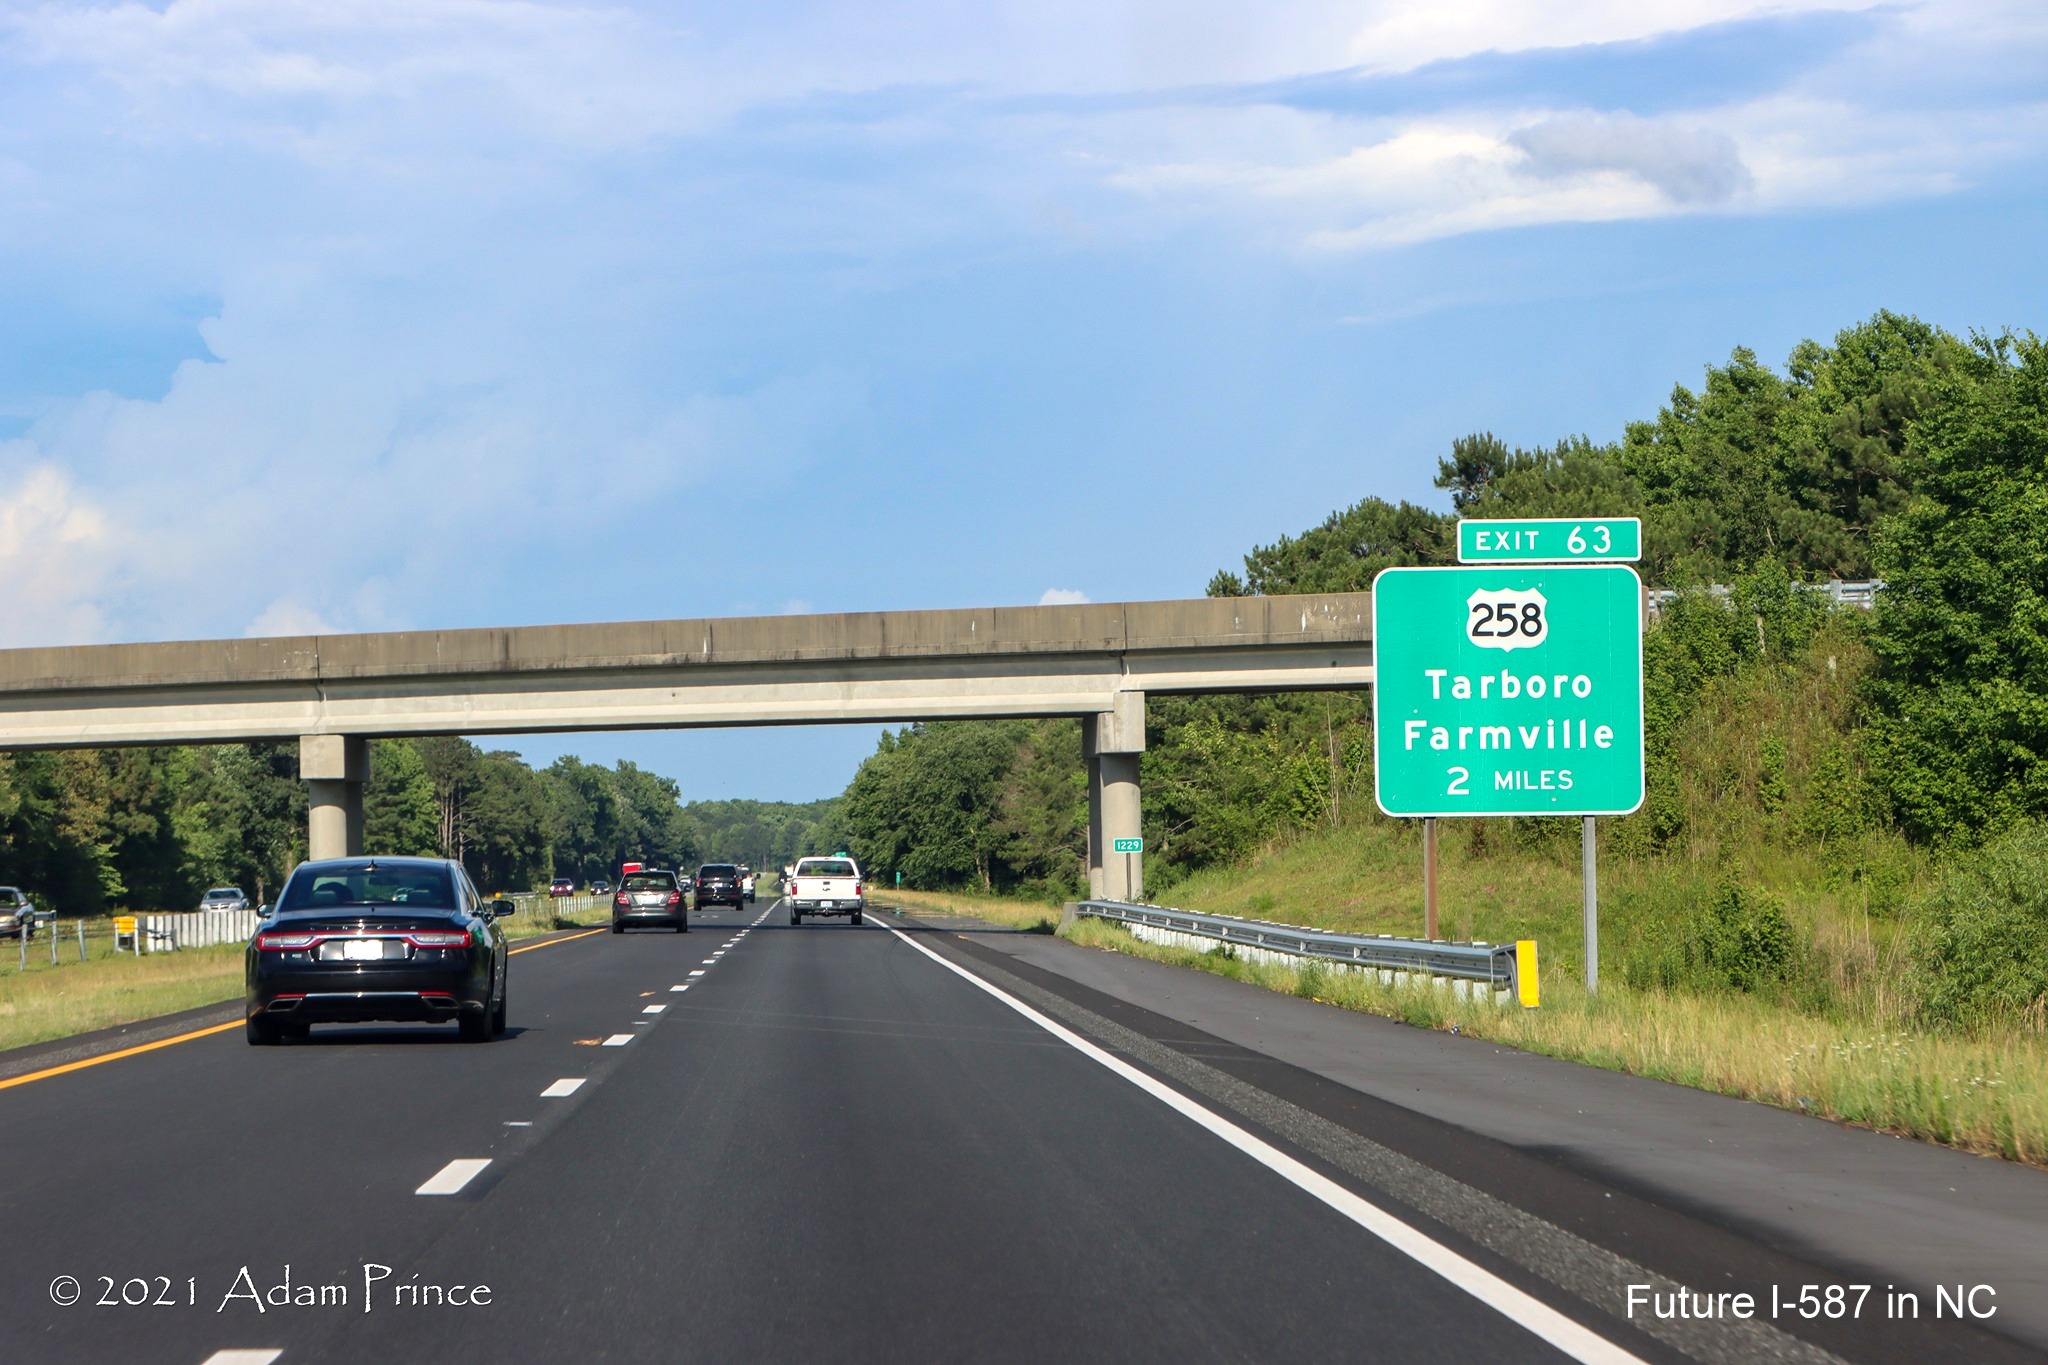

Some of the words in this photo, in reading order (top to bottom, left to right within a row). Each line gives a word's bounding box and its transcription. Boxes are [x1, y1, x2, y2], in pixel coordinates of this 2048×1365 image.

[1475, 531, 1540, 551] EXIT
[1567, 525, 1611, 554] 63
[1471, 603, 1542, 638] 258
[1424, 668, 1592, 700] Tarboro
[1404, 719, 1614, 751] Farmville
[1447, 766, 1470, 795] 2
[1494, 769, 1574, 790] MILES
[1117, 841, 1139, 850] 1229
